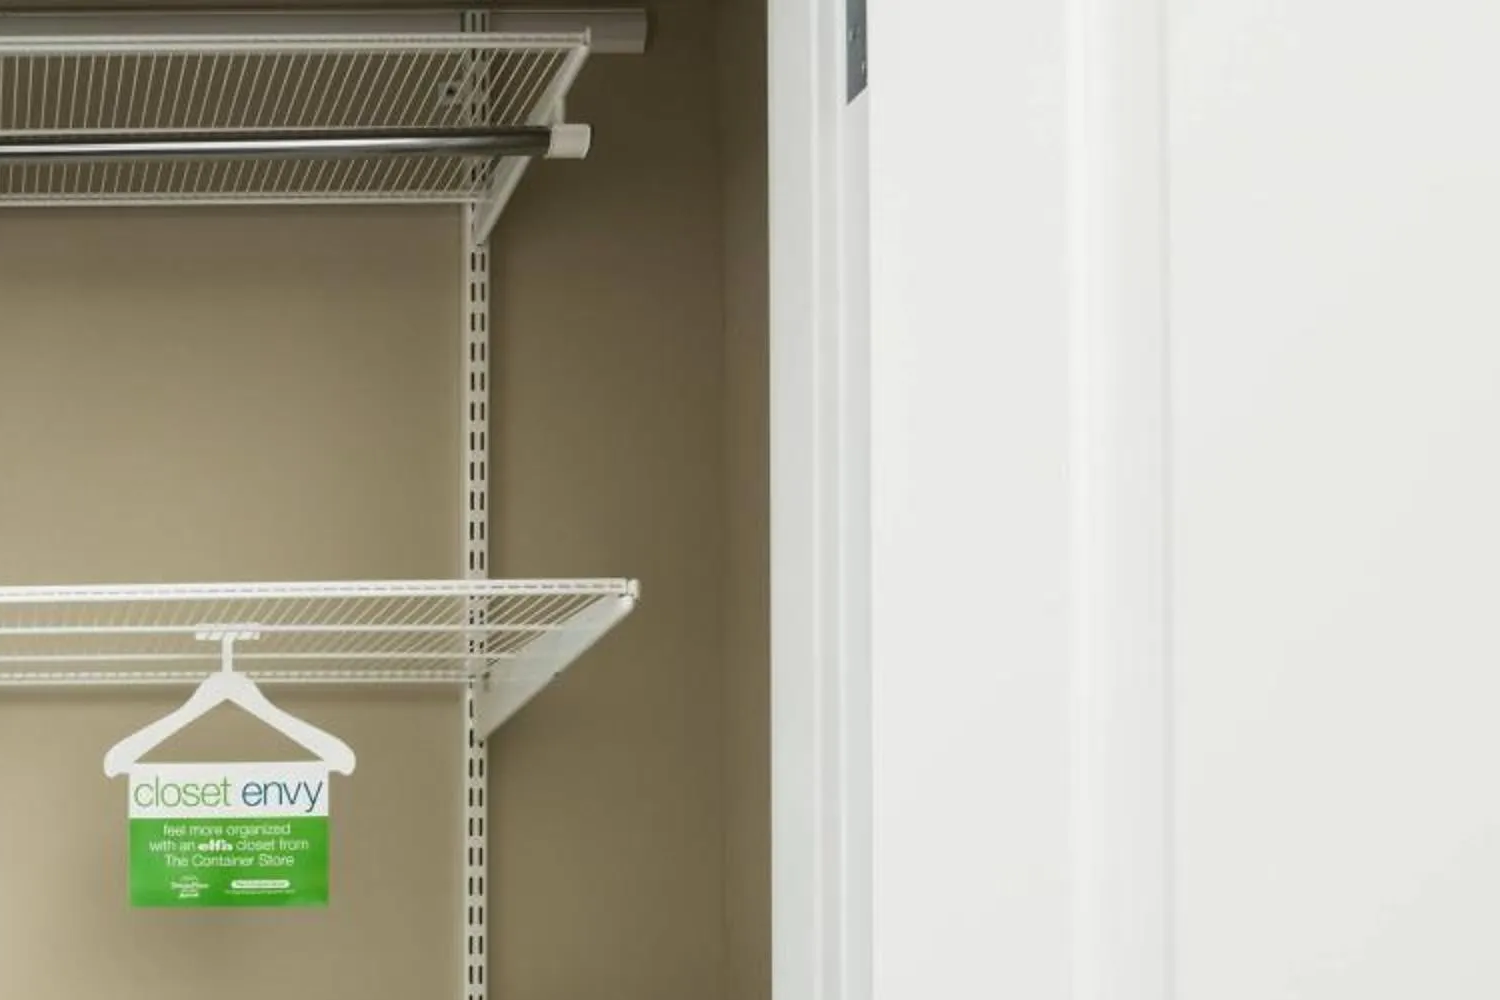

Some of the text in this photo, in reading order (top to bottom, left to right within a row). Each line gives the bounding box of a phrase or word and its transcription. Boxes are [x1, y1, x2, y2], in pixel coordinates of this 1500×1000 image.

[134, 776, 323, 812] closet envy
[164, 823, 291, 838] feel more organized
[150, 840, 176, 852] with
[180, 842, 195, 852] an
[236, 839, 274, 852] closet
[279, 838, 309, 851] from
[166, 853, 295, 867] The Container Store
